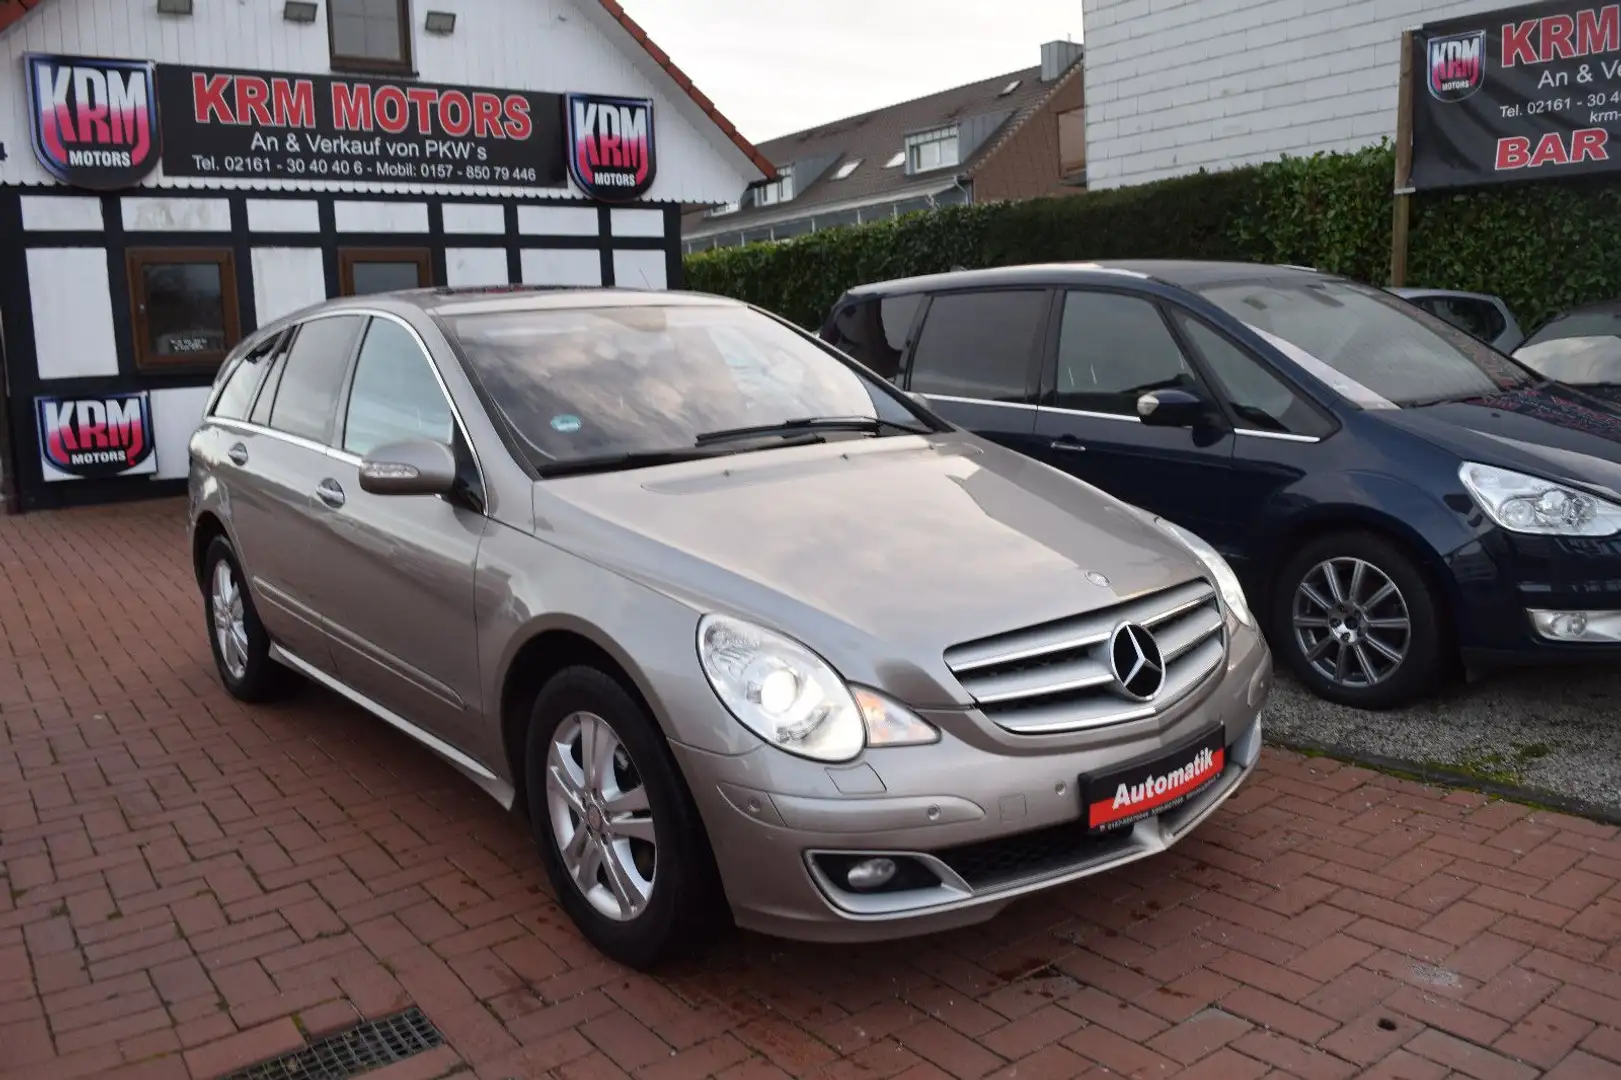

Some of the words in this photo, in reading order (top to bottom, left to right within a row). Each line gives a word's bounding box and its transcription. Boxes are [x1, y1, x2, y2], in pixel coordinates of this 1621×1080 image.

[1501, 4, 1620, 68] KRM
[1432, 38, 1480, 88] KRM
[1537, 70, 1568, 89] An
[1576, 63, 1593, 83] &
[1442, 80, 1470, 91] MOTORS
[38, 65, 150, 164] KRM
[191, 71, 316, 129] KRM
[330, 81, 533, 141] MOTORS
[1500, 104, 1523, 118] Tel.
[1527, 97, 1571, 115] 02161
[1587, 93, 1606, 107] 30
[68, 150, 132, 168] MOTORS
[250, 131, 279, 152] An
[285, 132, 300, 152] &
[305, 133, 381, 156] Verkauf
[386, 142, 420, 158] von
[575, 102, 648, 184] KRM
[1494, 127, 1610, 170] BAR
[191, 154, 220, 171] Tel.
[224, 156, 271, 172] 02161
[286, 158, 305, 173] 30
[308, 159, 328, 174] 40
[331, 160, 350, 174] 40
[353, 160, 364, 176] 6
[376, 161, 417, 177] Mobil:
[419, 163, 453, 178] 0157
[465, 165, 491, 180] 850
[494, 166, 510, 181] 79
[512, 167, 537, 181] 446
[594, 172, 636, 186] MOTORS
[44, 398, 143, 465] KRM
[71, 450, 126, 466] MOTORS
[1112, 746, 1213, 810] Automatik
